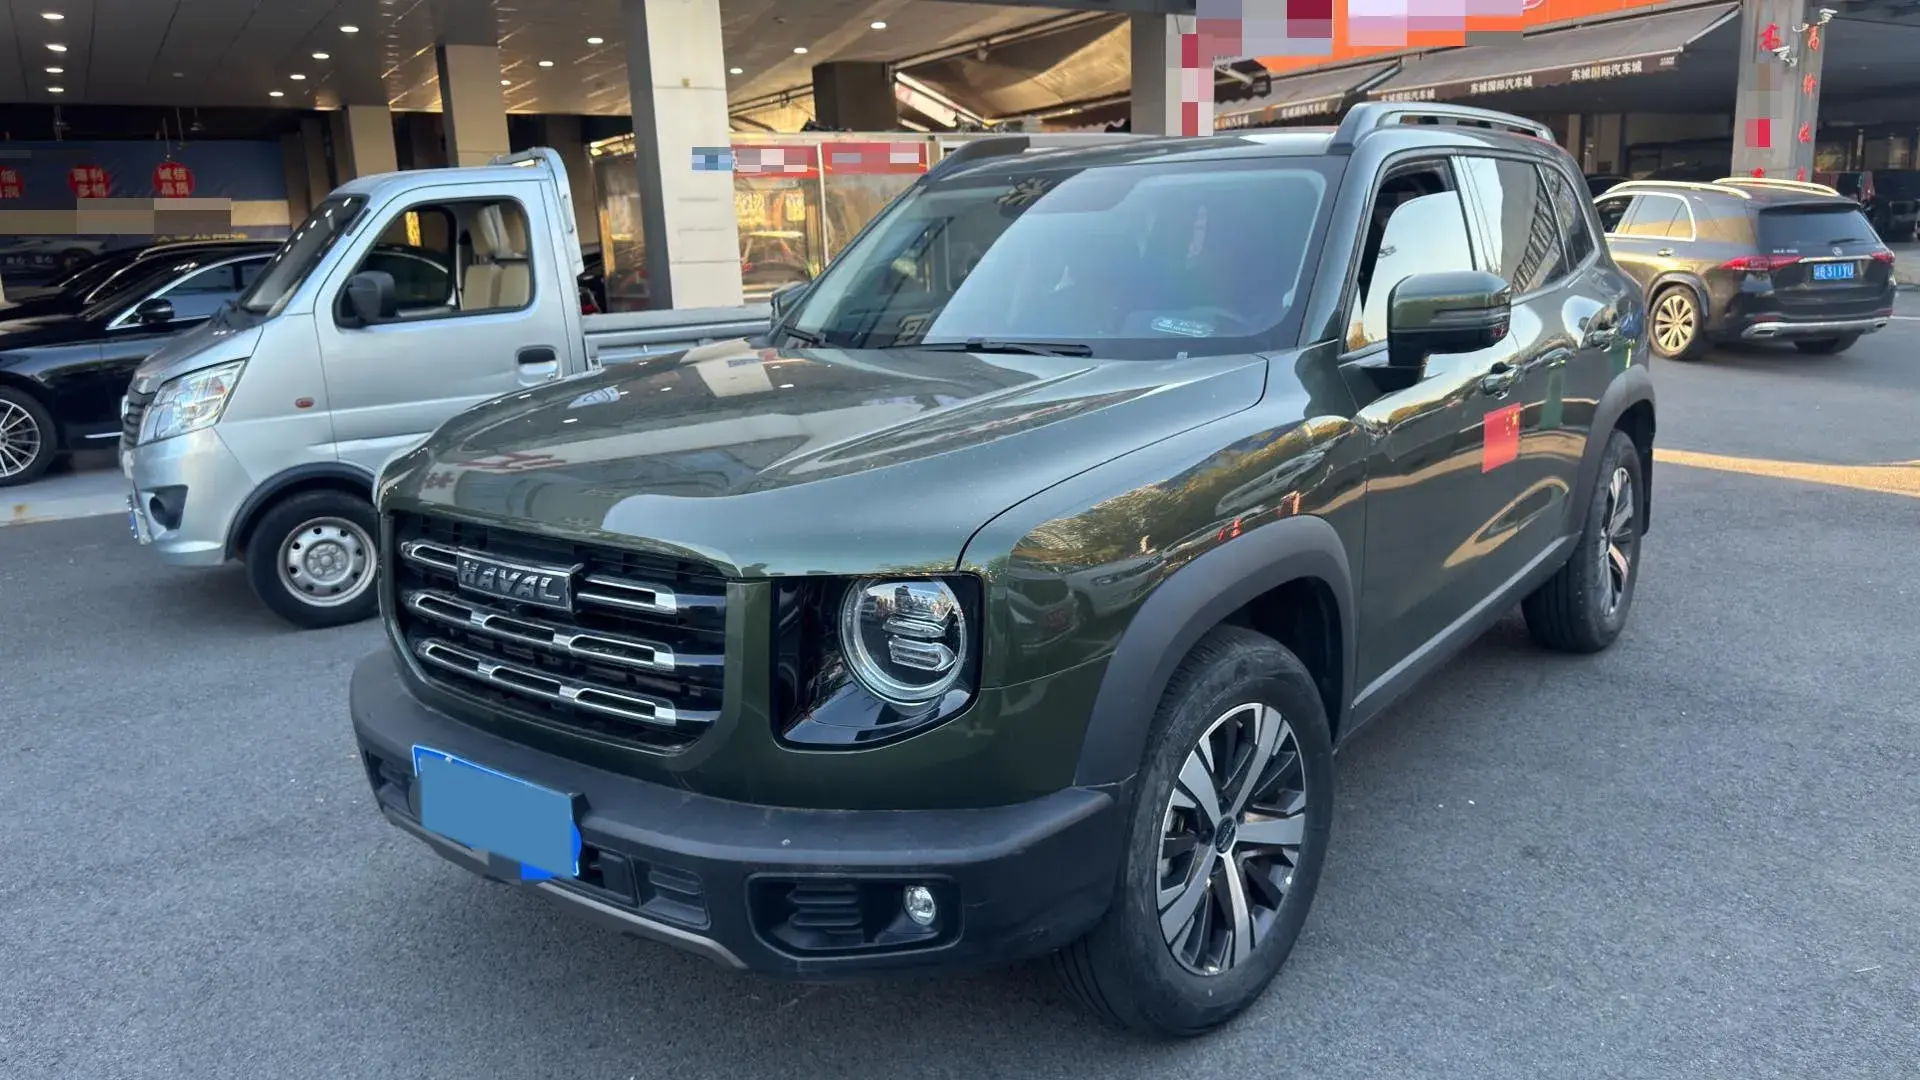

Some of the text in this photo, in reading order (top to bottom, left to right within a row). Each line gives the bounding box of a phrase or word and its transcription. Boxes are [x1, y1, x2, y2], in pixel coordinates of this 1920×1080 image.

[1570, 60, 1643, 82] 东城国际汽车城
[1470, 75, 1534, 94] 东城国际汽车城
[461, 560, 561, 600] HAVAL
